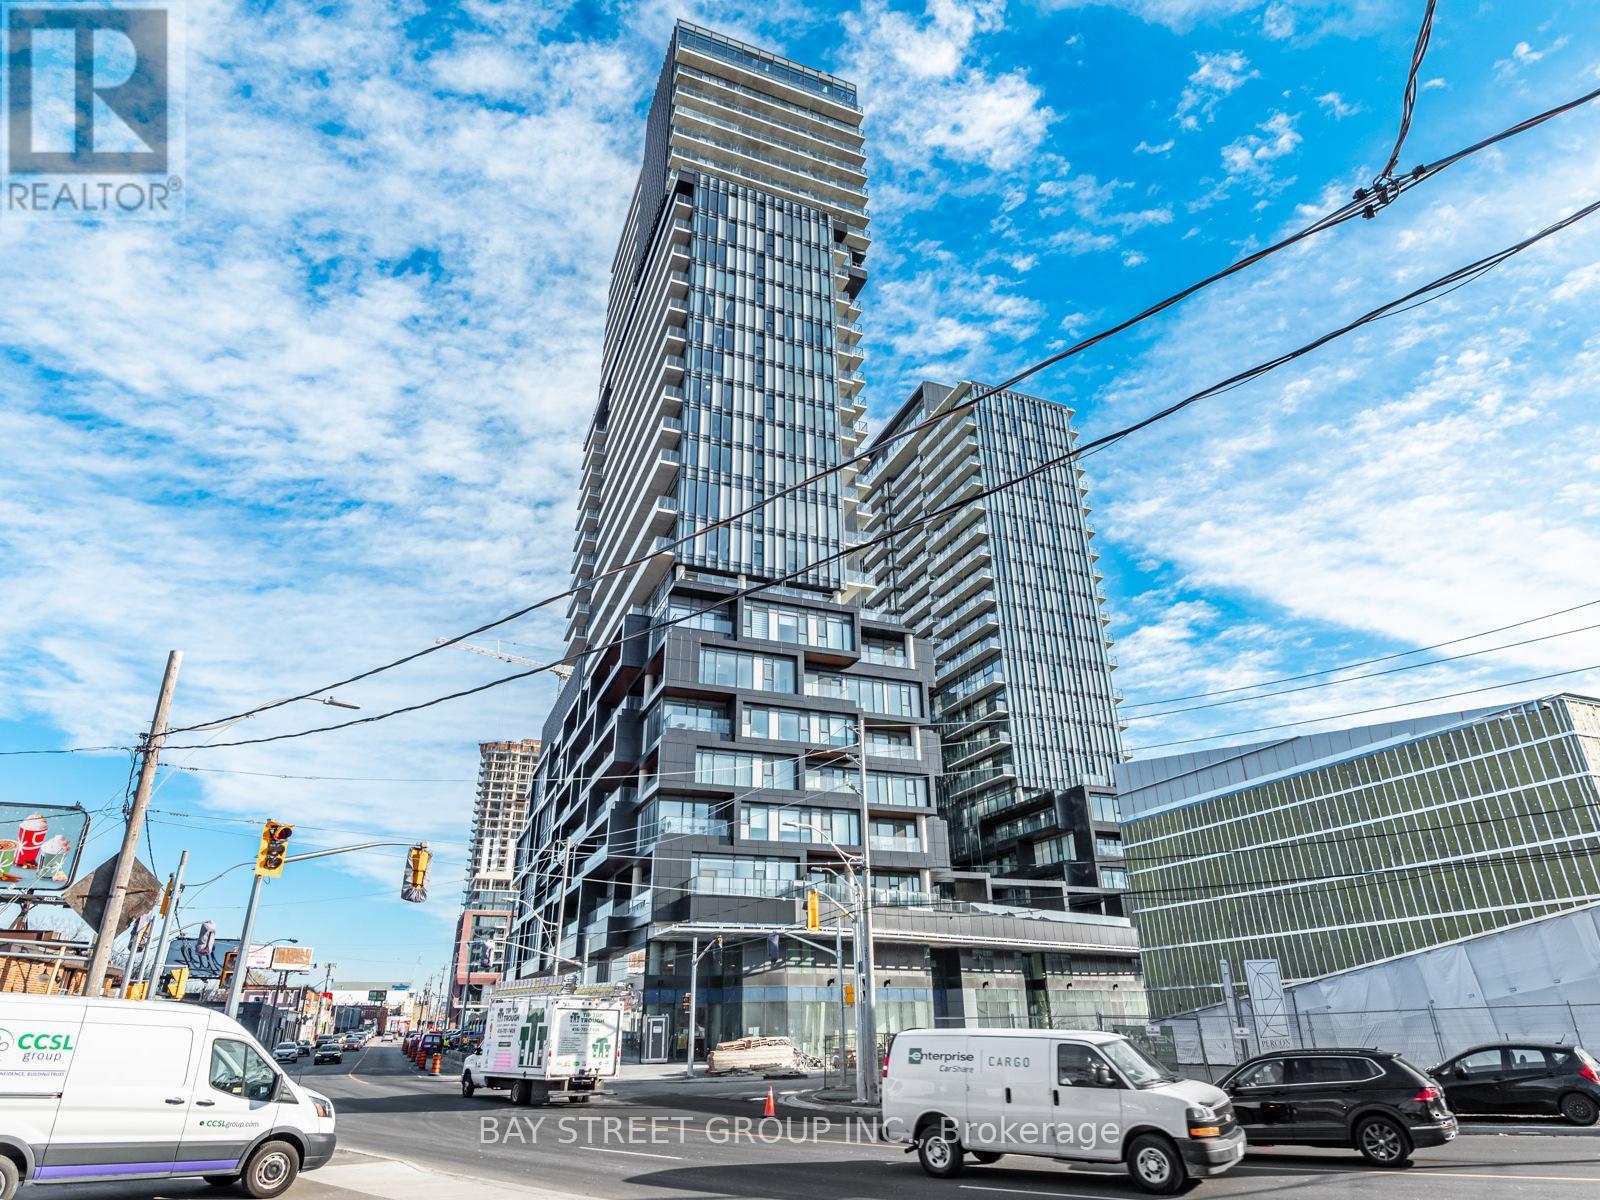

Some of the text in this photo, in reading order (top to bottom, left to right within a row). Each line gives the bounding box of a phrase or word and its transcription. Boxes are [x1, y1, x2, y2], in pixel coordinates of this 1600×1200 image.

[17, 1033, 74, 1050] CCSL
[22, 1051, 62, 1062] group
[988, 1056, 1030, 1067] CARGO
[939, 1065, 974, 1073] CarShare
[206, 1120, 260, 1128] CCSLgroup.com
